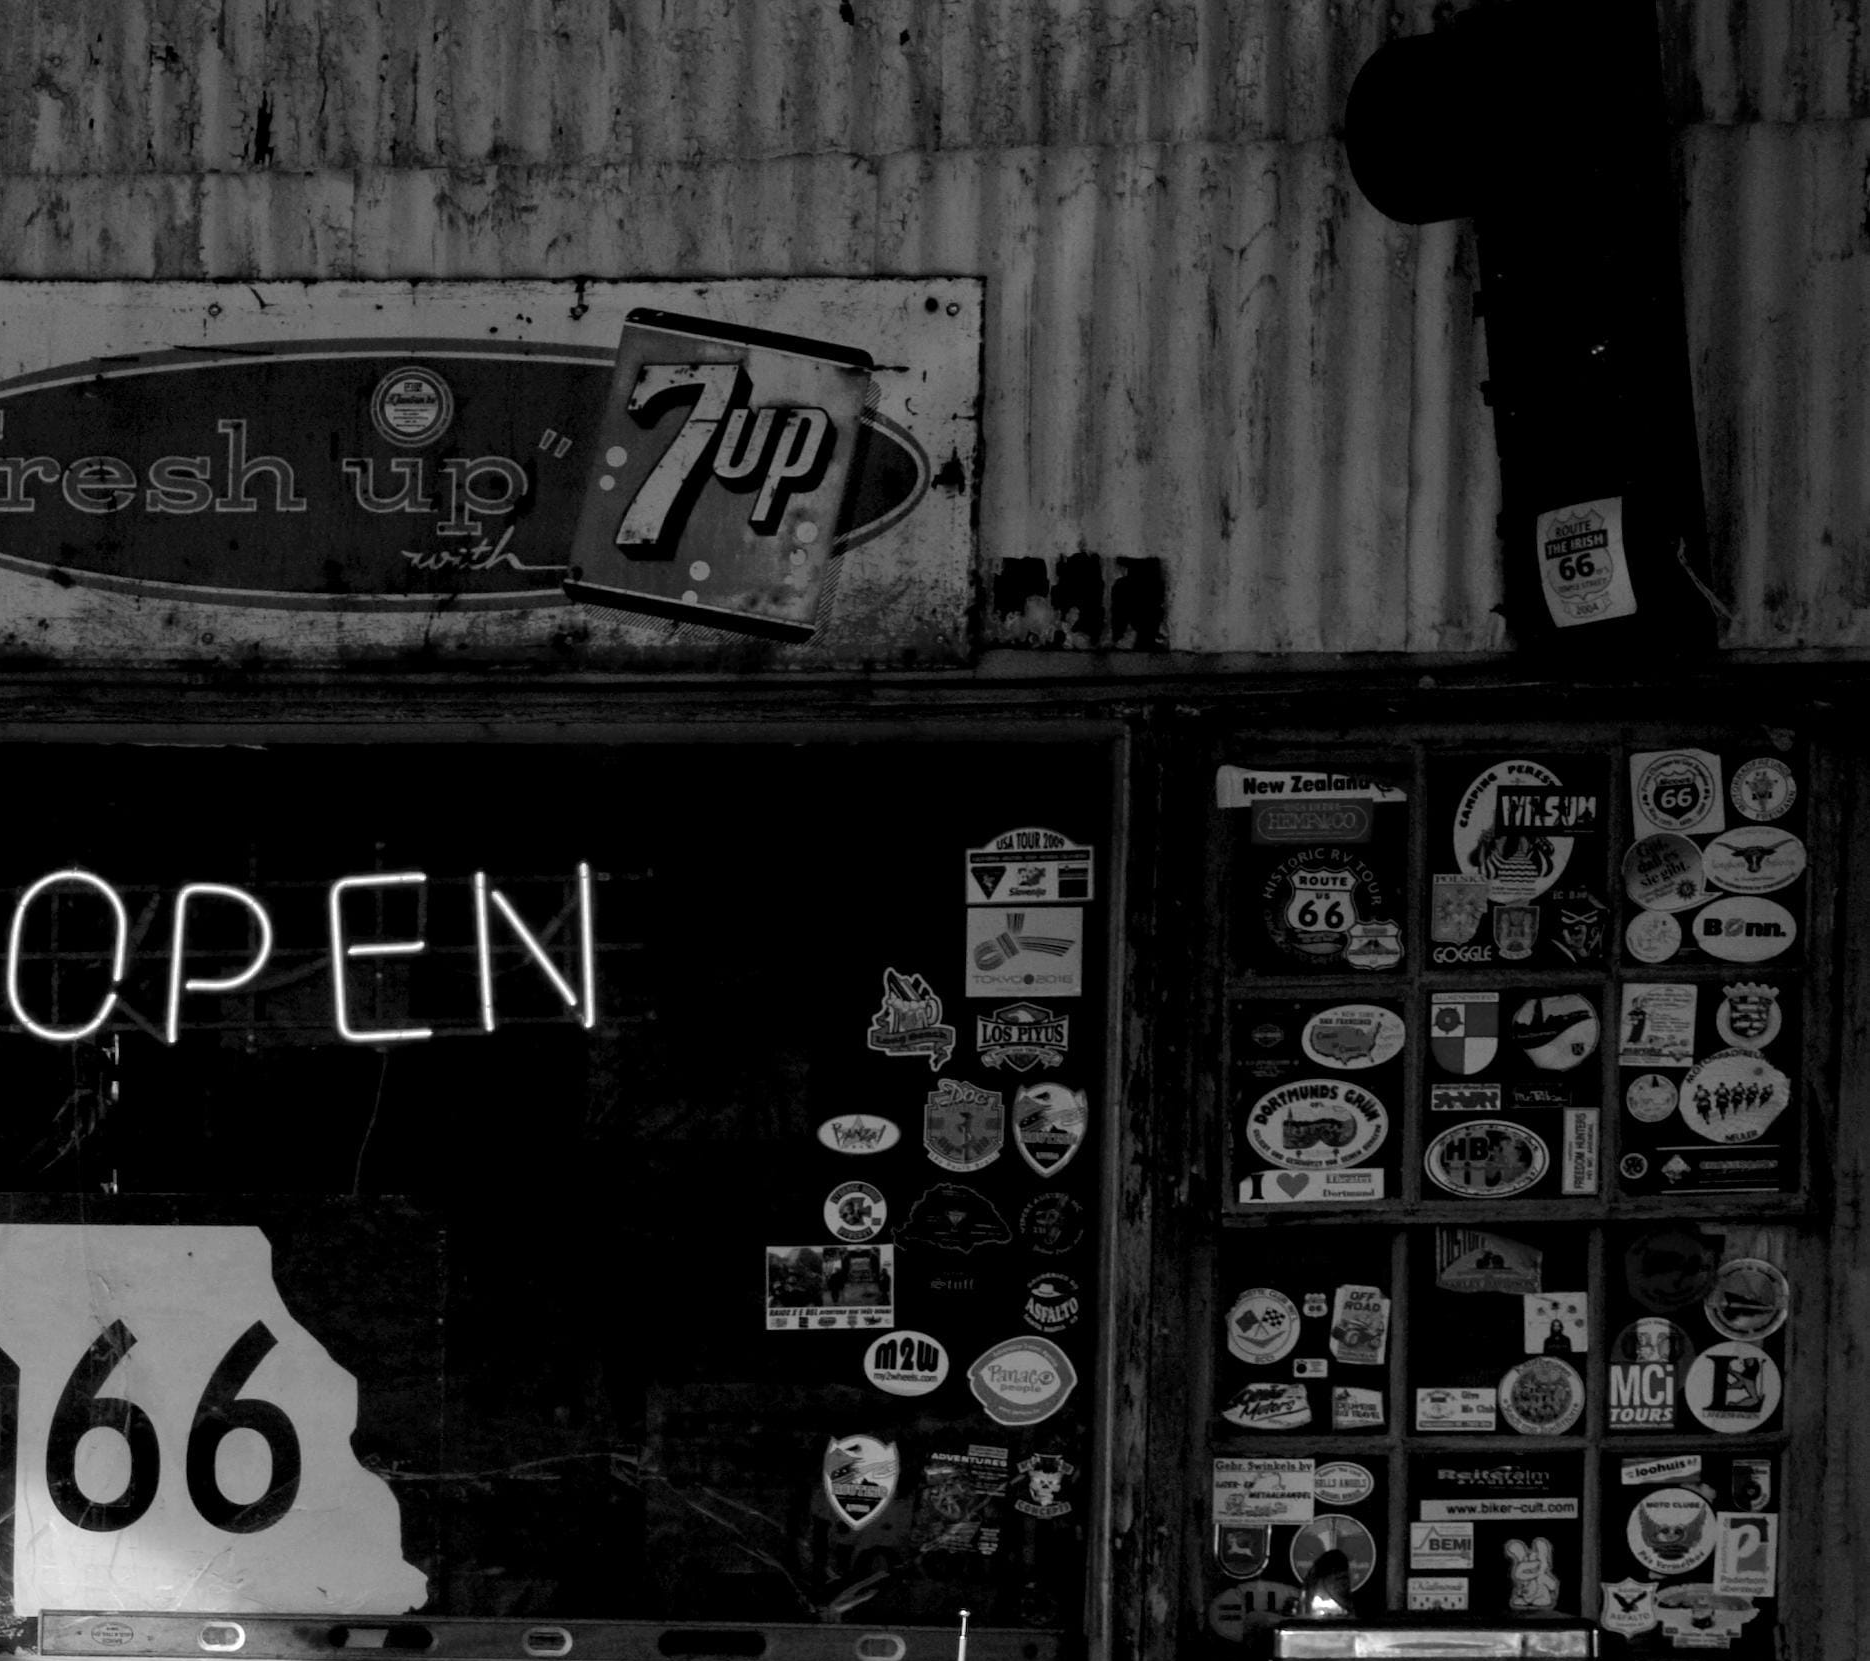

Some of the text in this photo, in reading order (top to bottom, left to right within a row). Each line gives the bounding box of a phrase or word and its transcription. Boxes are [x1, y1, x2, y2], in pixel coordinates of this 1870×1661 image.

[1555, 520, 1592, 537] ROUTE
[1547, 533, 1604, 557] THE IRISH
[1559, 552, 1595, 581] 66
[1243, 775, 1372, 794] New Zealand
[1459, 772, 1498, 828] CAMPING
[1660, 787, 1693, 809] 66
[996, 834, 1014, 850] USA
[1016, 831, 1041, 850] TOUR
[1262, 848, 1383, 907] HISTORIC RV TOUR
[1299, 876, 1348, 887] ROUTE
[1298, 900, 1345, 930] 66
[6, 861, 597, 1044] OPEN
[1432, 944, 1492, 964] GOGGLE
[972, 974, 1023, 985] TOKYO
[981, 1023, 1065, 1043] LOS PIYUS
[1253, 1084, 1339, 1126] DORTMUNDS
[1573, 1112, 1588, 1189] FREEDOM HUNTERS
[1349, 1290, 1376, 1301] OFF
[1024, 1296, 1079, 1324] ASFALTO
[1343, 1301, 1382, 1313] ROAD
[873, 1372, 938, 1383] my2wheels.com
[999, 1383, 1042, 1394] people
[1610, 1408, 1674, 1422] TOURS
[45, 1317, 302, 1534] 66
[930, 1452, 1008, 1468] ADVENTURES
[1215, 1460, 1245, 1472] Gehr.
[1247, 1460, 1298, 1472] Swinkels
[1635, 1460, 1687, 1478] loohuis
[1446, 1502, 1575, 1515] www.biker-cult.com
[1428, 1538, 1472, 1551] BEMI
